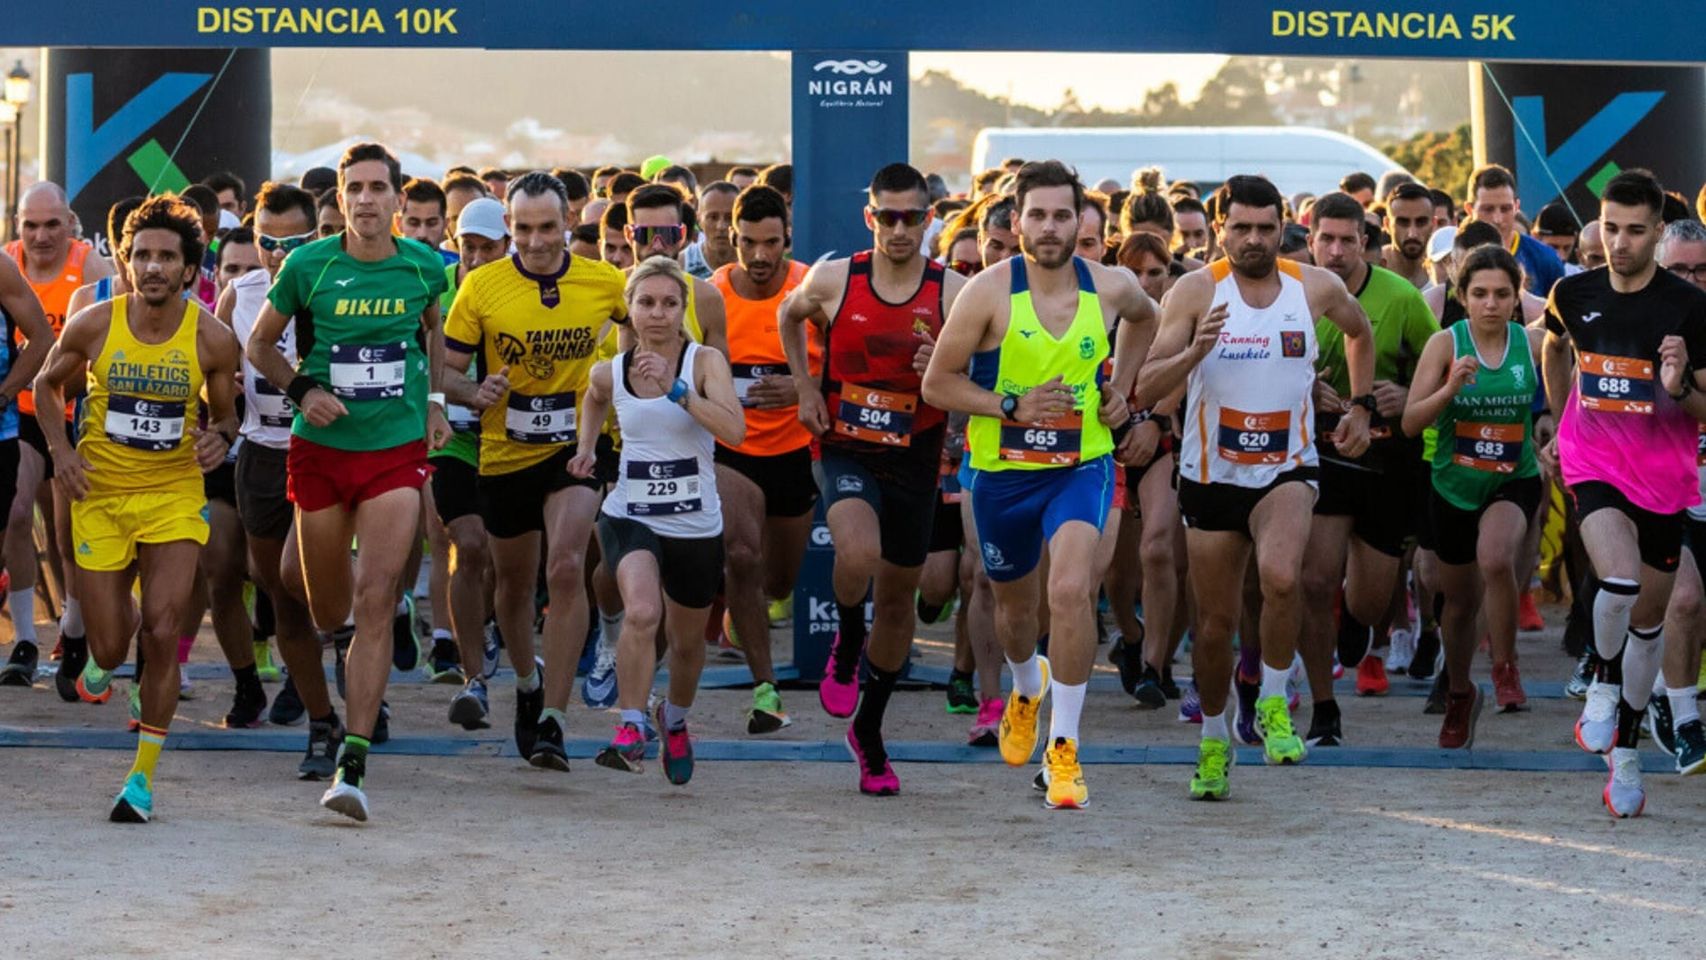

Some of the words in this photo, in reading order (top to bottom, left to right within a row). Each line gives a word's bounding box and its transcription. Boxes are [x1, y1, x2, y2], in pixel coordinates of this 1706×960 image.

[198, 7, 385, 33] DISTANCIA
[395, 8, 458, 34] 10K
[1272, 10, 1462, 39] DISTANCIA
[1471, 14, 1516, 41] 5K
[808, 77, 892, 95] NIGRÁN
[526, 326, 592, 343] TANINOS
[1218, 331, 1270, 348] Running
[108, 362, 190, 382] ATHLETICS
[366, 366, 375, 380] 1
[108, 379, 135, 392] SAN
[1598, 377, 1630, 393] 688
[1454, 395, 1481, 406] SAN
[532, 414, 552, 427] 49
[859, 407, 892, 425] 504
[131, 418, 161, 433] 143
[1024, 429, 1058, 446] 665
[1238, 432, 1270, 447] 620
[1475, 441, 1504, 456] 683
[647, 481, 678, 496] 229
